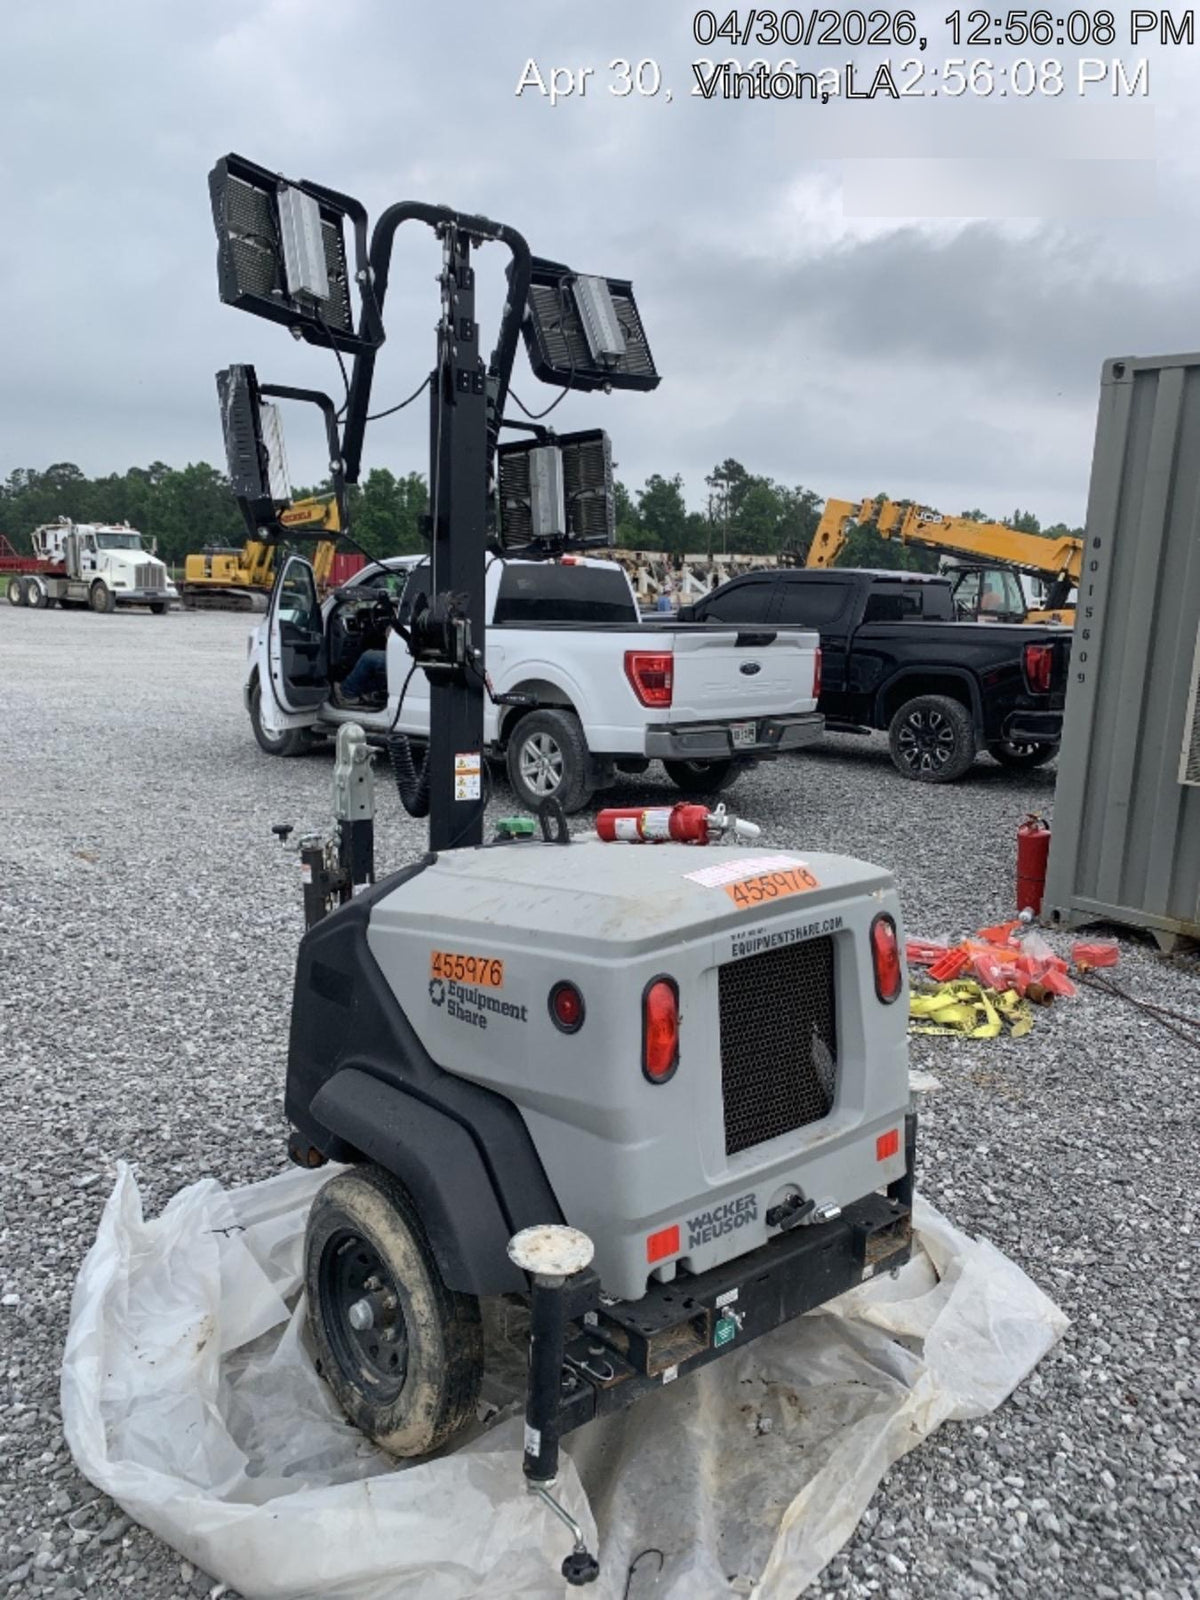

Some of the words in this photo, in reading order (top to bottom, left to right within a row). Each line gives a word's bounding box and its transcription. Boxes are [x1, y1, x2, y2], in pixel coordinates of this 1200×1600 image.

[432, 953, 503, 986] 455976
[448, 980, 528, 1022] Equipment
[448, 999, 488, 1030] Share
[686, 1193, 757, 1232] WACKER
[689, 1207, 757, 1249] NEUSON
